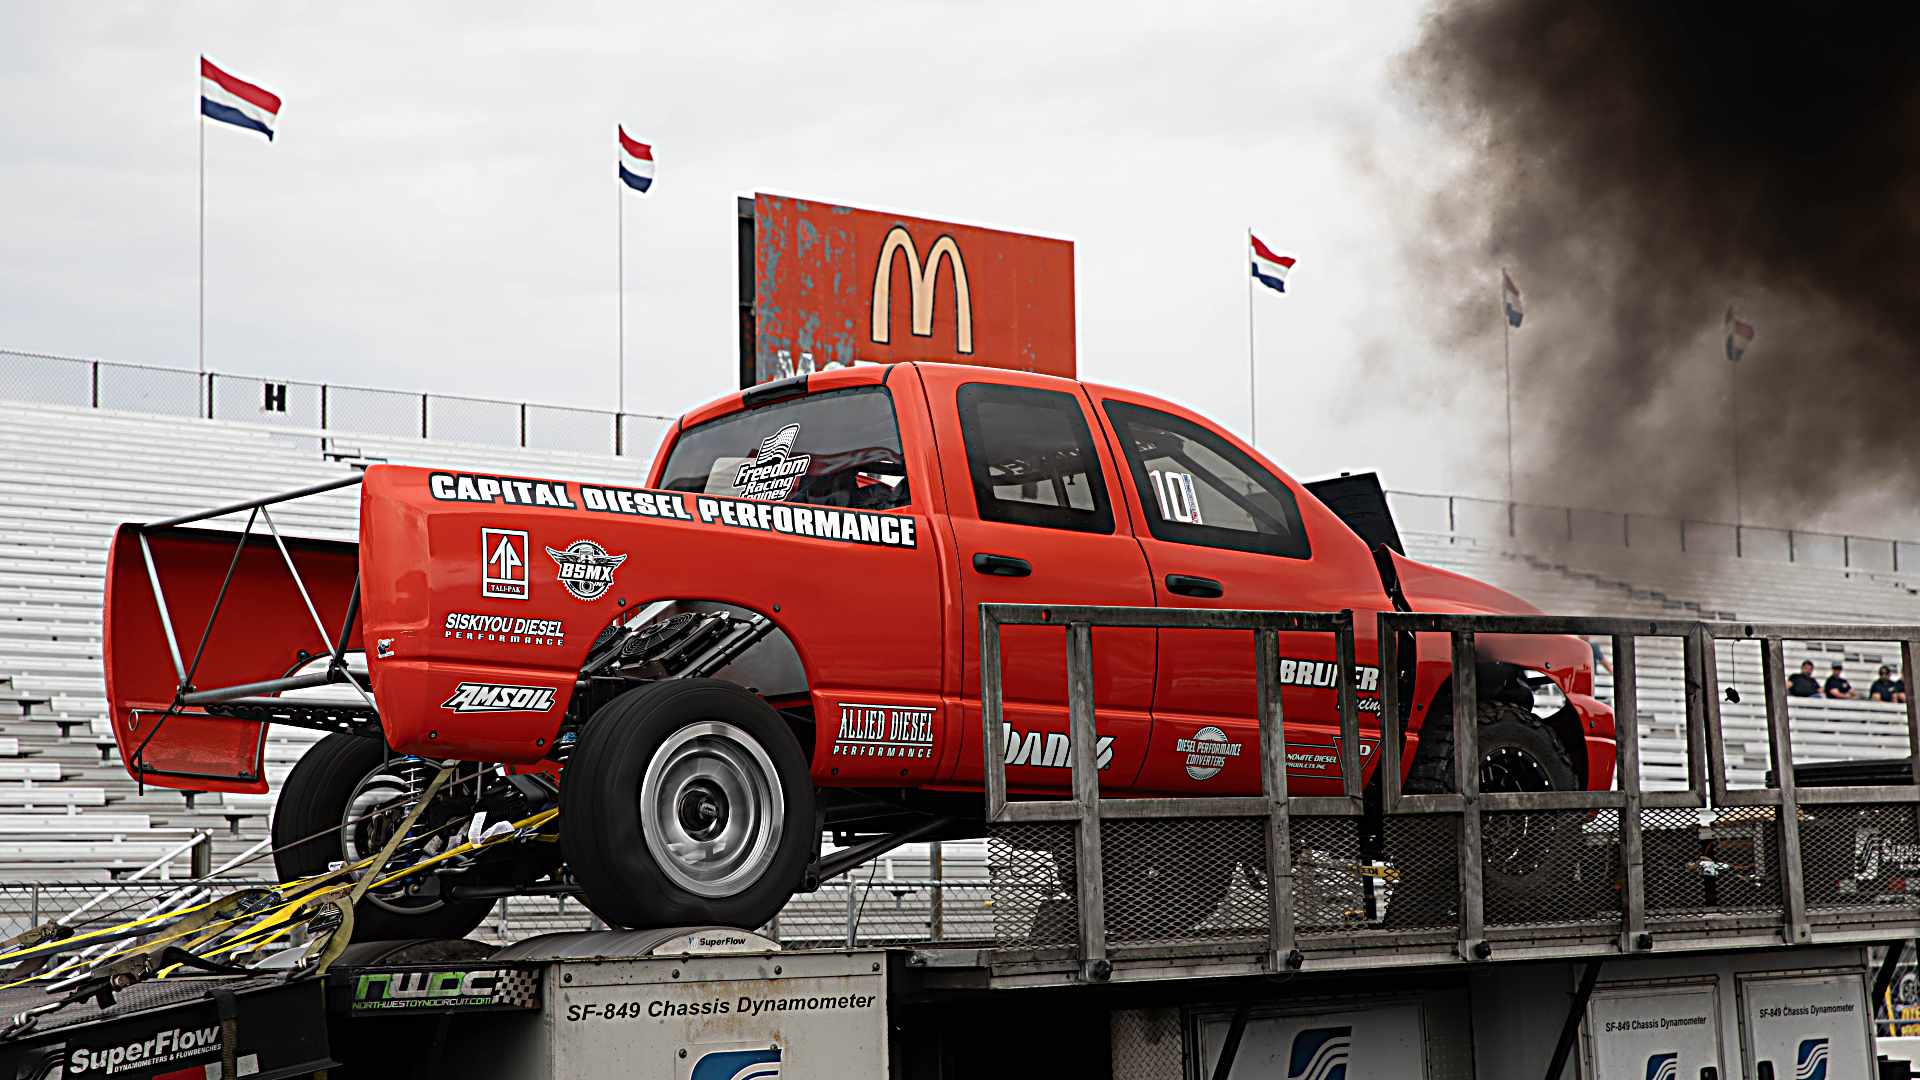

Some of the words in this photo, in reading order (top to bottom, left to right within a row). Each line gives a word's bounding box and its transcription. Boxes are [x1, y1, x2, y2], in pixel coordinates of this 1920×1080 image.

[264, 383, 287, 412] H
[735, 459, 807, 486] Freedom
[745, 476, 794, 494] Racing
[1149, 469, 1193, 523] 10
[430, 474, 576, 509] CAPITAL
[582, 486, 692, 521] DIESEL
[699, 498, 916, 546] PERFORMANCE
[560, 562, 614, 582] BSMX
[490, 584, 521, 593] TALI-PAK
[445, 613, 514, 633] SISKIYOU
[513, 618, 565, 637] DIESEL
[445, 631, 564, 646] PERFORMANCE
[448, 684, 553, 711] AMSOIL
[838, 708, 886, 740] ALLIED
[889, 711, 933, 742] DIESEL
[833, 745, 932, 759] PERFORMANCE
[1176, 738, 1197, 753] DIESEL
[1196, 741, 1242, 756] PERFORMANCE
[1186, 753, 1226, 767] CONVERTERS
[1286, 753, 1314, 762] NOMITE
[699, 936, 747, 948] SuperFlow
[566, 1001, 641, 1022] SF-849
[647, 997, 731, 1018] Chassis
[736, 992, 877, 1015] Dynamometer
[1759, 1007, 1782, 1018] SF-849
[1783, 1006, 1809, 1017] Chassis
[1810, 1003, 1855, 1016] Dynamometer
[1605, 1021, 1631, 1032] SF-849
[1631, 1019, 1659, 1030] Chassis
[1660, 1016, 1707, 1030] Dynamometer
[69, 1026, 220, 1075] SuperFlow
[114, 1055, 168, 1073] DYNAMOMETERS
[176, 1043, 222, 1060] FLOWBENCHES
